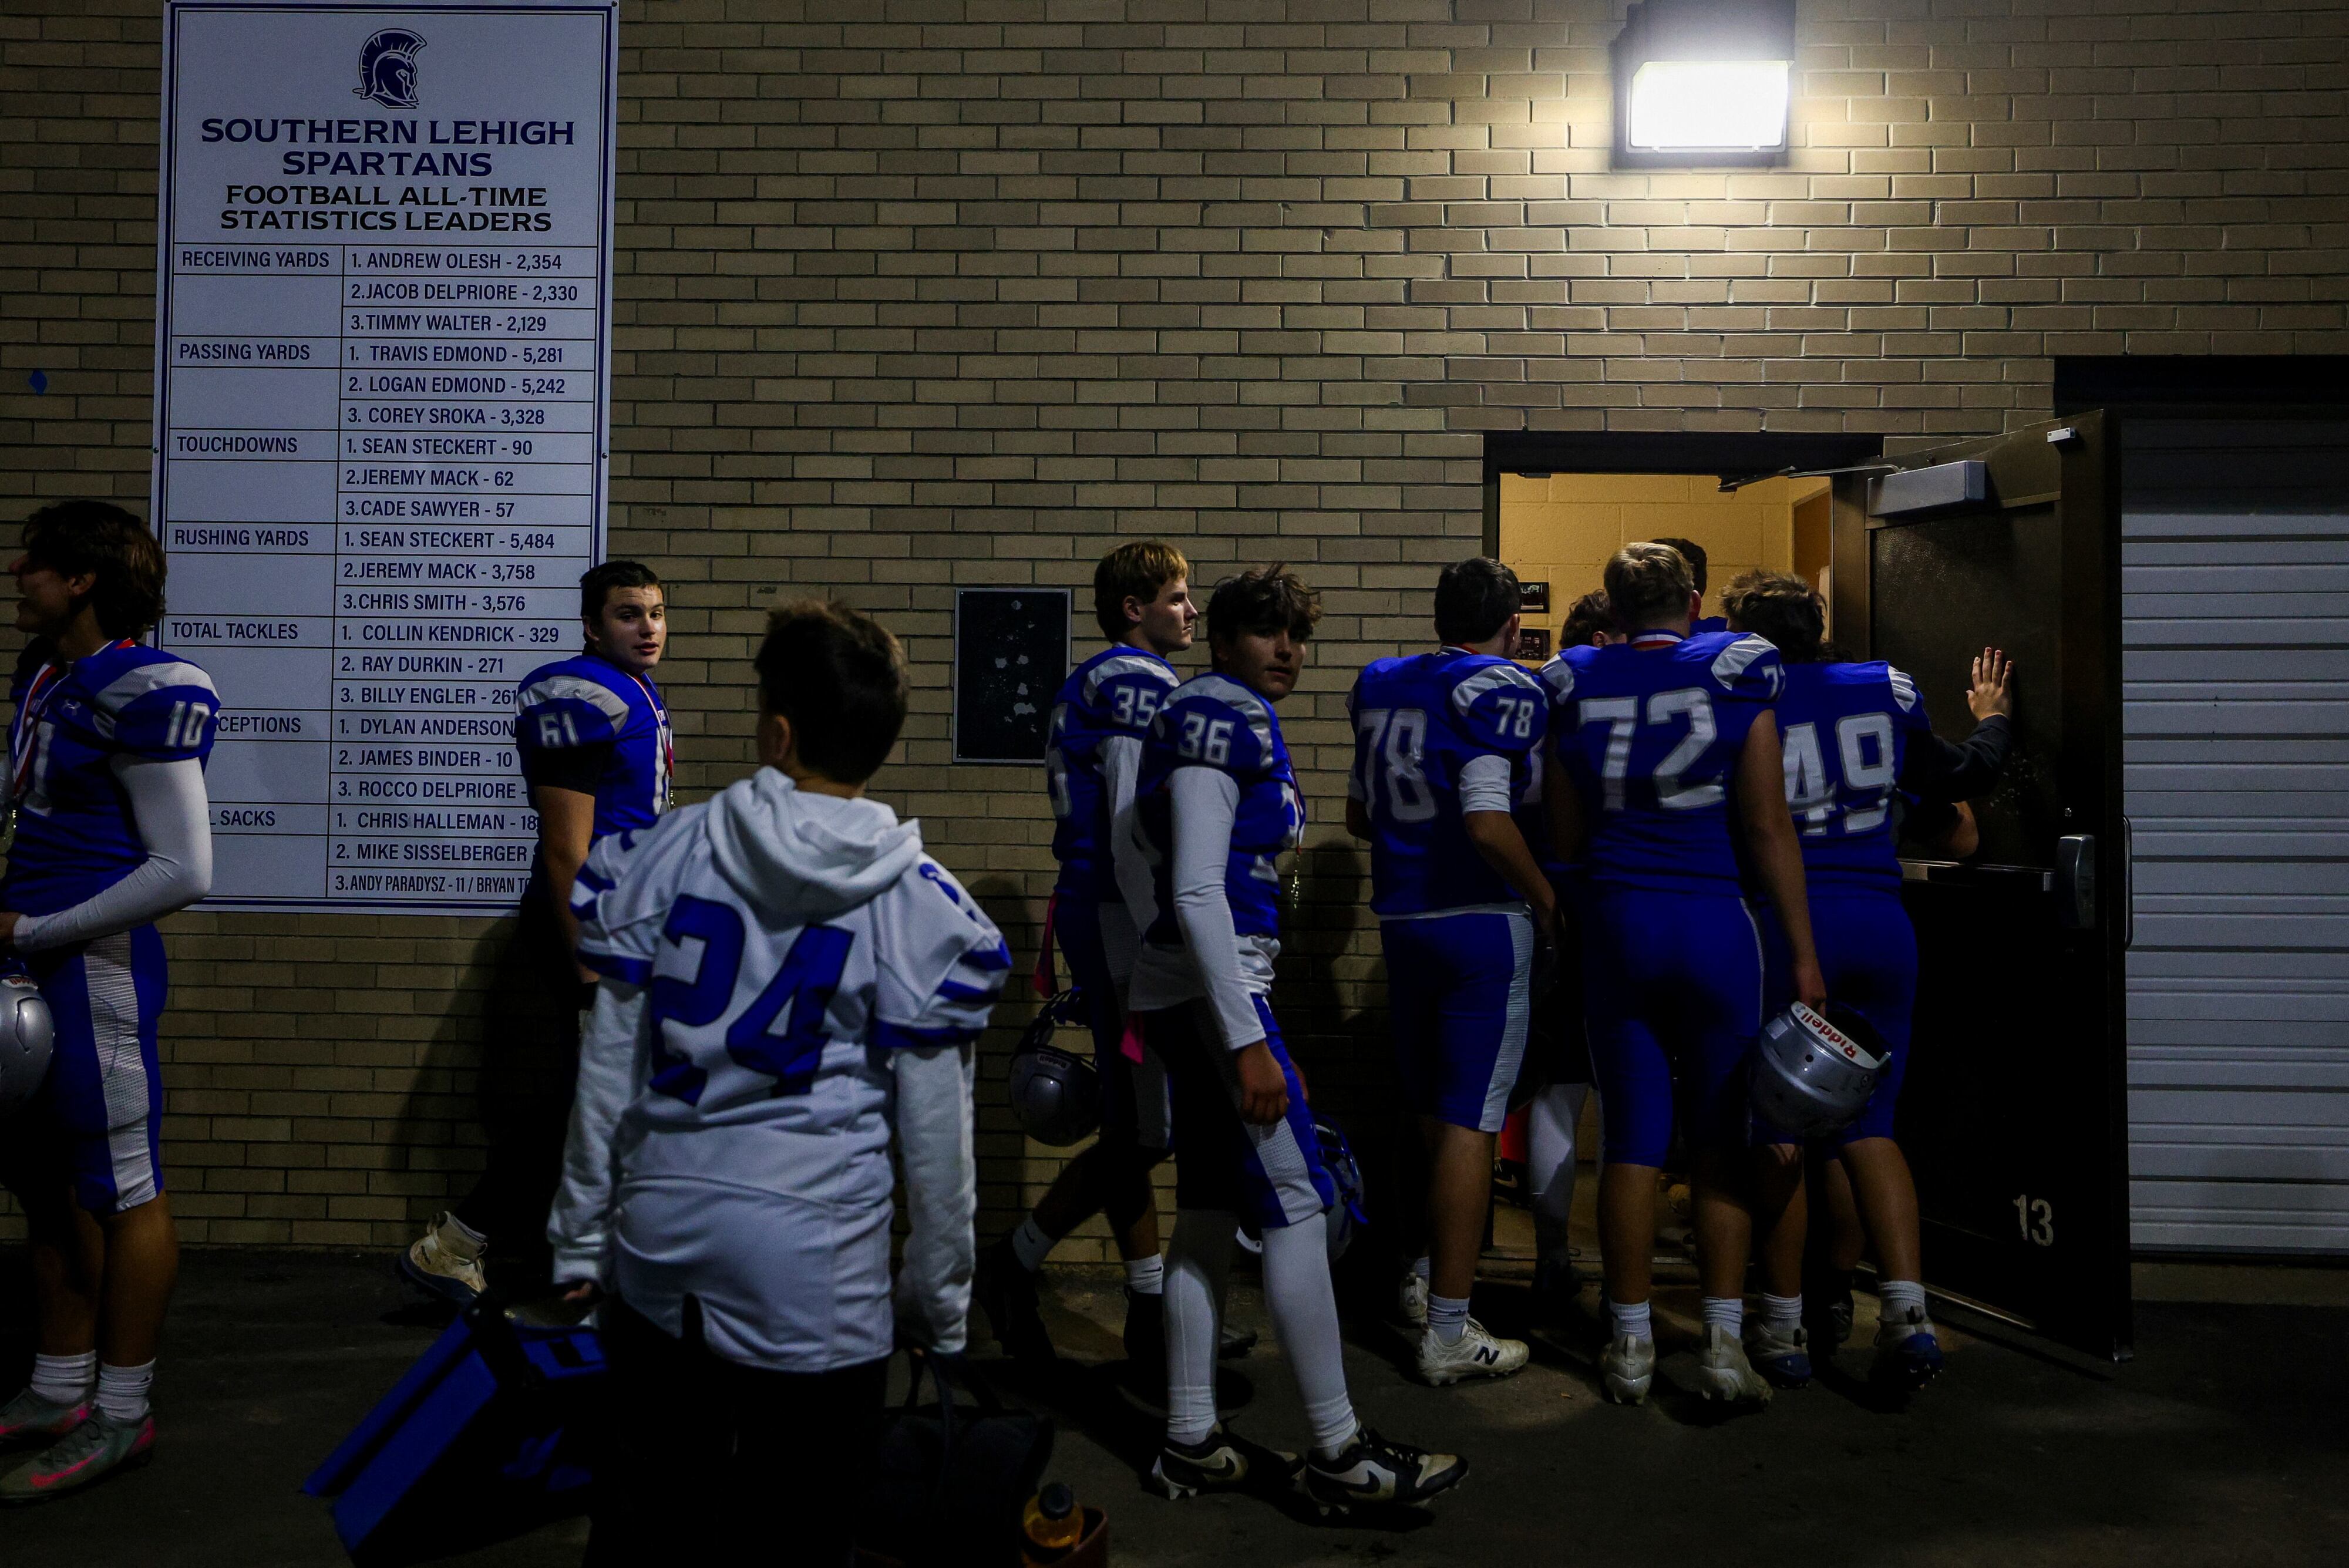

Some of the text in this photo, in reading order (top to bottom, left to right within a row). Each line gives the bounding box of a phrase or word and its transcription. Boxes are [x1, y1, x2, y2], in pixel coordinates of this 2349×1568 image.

[201, 118, 574, 145] SOUTHERN LEHIGH
[282, 151, 492, 177] SPARTANS
[226, 184, 547, 207] FOOTBALL ALL-TIME
[221, 210, 551, 232] STATISTICS LEADERS
[182, 251, 329, 268] RECEIVING YARDS
[352, 253, 361, 268] 1.
[366, 253, 442, 268] ANDREW
[446, 253, 501, 269] OLESH
[516, 254, 562, 272] 2,354
[425, 284, 517, 300] DELPRIORE
[533, 285, 578, 303] 2,330
[426, 315, 492, 331] WALTER
[507, 316, 546, 334] 2,129
[180, 343, 310, 360] PASSING YARDS
[349, 345, 359, 361] 1.
[369, 345, 428, 362] TRAVIS
[433, 346, 507, 362] EDMOND
[523, 347, 562, 365] 5,281
[348, 376, 362, 392] 2.
[369, 376, 426, 392] LOGAN
[432, 377, 506, 393] EDMOND
[521, 378, 565, 396] 5,242
[348, 407, 361, 423] 3.
[368, 407, 425, 423] COREY
[429, 408, 486, 424] SROKA
[501, 409, 544, 426] 3,328
[176, 436, 297, 453] TOUCHDOWNS
[346, 438, 356, 453] 1.
[362, 438, 407, 454] SEAN
[412, 438, 497, 455] STECKERT
[512, 440, 533, 456] 90
[430, 470, 479, 486] MACK
[494, 471, 514, 486] 62
[410, 500, 480, 517] SAWYER
[496, 502, 514, 517] 57
[175, 529, 309, 546] RUSHING YARDS
[344, 531, 354, 547] 1.
[360, 531, 405, 547] SEAN
[409, 531, 494, 548] STECKERT
[510, 533, 555, 551] 5,484
[428, 563, 477, 579] MACK
[492, 564, 535, 582] 3,758
[413, 594, 466, 610] SMITH
[482, 595, 526, 613] 3,576
[171, 622, 298, 640] TOTAL TACKLES
[342, 625, 352, 640] 1.
[362, 625, 423, 641] COLLIN
[429, 625, 514, 642] KENDRICK
[529, 627, 559, 643] 329
[341, 656, 355, 671] 2.
[362, 656, 394, 672] RAY
[398, 656, 462, 673] DURKIN
[478, 658, 503, 673] 271
[341, 687, 354, 703] 3.
[361, 687, 406, 703] BILLY
[410, 688, 476, 704] ENGLER
[492, 689, 517, 705] 261
[1111, 684, 1160, 728] 35
[164, 700, 211, 748] 10
[218, 715, 302, 733] CEPTIONS
[339, 718, 514, 736] 1. DYLAN ANDERSON
[1495, 696, 1535, 739] 78
[537, 709, 582, 749] 61
[1177, 710, 1236, 767] 36
[338, 749, 352, 765] 2.
[359, 749, 413, 766] JAMES
[418, 751, 480, 767] BINDER
[496, 752, 513, 768] 10
[1576, 687, 1727, 813] 72
[1357, 708, 1439, 823] 78
[1782, 711, 1897, 836] 49
[338, 780, 352, 796] 3.
[359, 780, 418, 798] ROCCO
[423, 782, 516, 799] DELPRIORE
[220, 810, 275, 826] SACKS
[337, 812, 346, 827] 1.
[358, 812, 408, 829] CHRIS
[413, 813, 504, 830] HALLEMAN
[336, 843, 527, 862] 2. MIKE SISSELBERGER
[385, 876, 446, 892] PARADYSZ
[455, 877, 465, 892] 11
[467, 877, 474, 893] /
[477, 877, 515, 893] BRYAN
[649, 893, 854, 1106] 24
[1801, 1012, 1857, 1059] Riddell
[2013, 1193, 2055, 1247] 13
